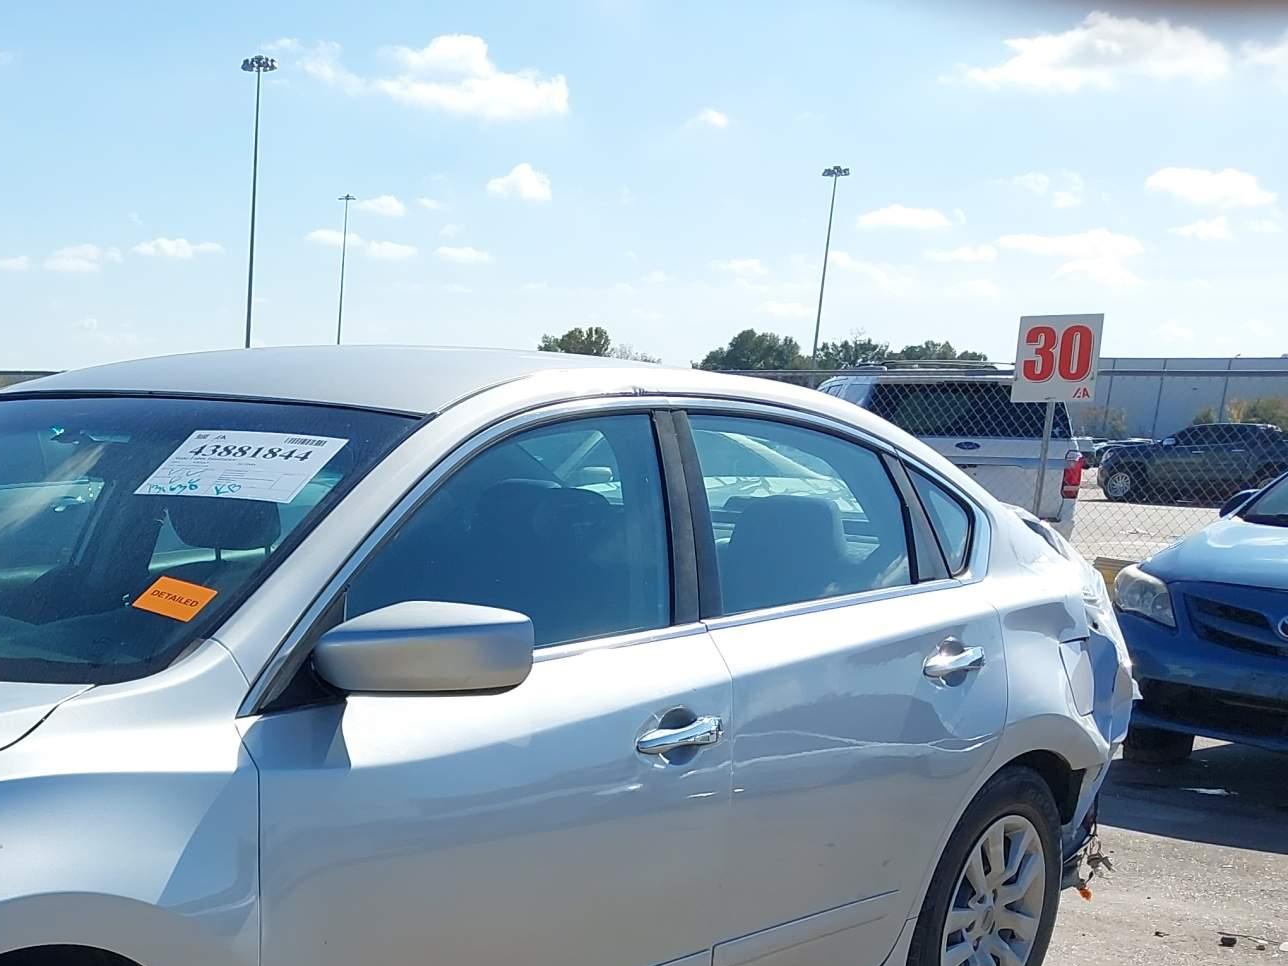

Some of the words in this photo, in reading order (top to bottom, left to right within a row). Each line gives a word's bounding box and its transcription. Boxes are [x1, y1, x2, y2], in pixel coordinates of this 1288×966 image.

[1022, 324, 1094, 383] 30
[189, 443, 313, 462] 43881844
[151, 589, 200, 608] DETAILED
